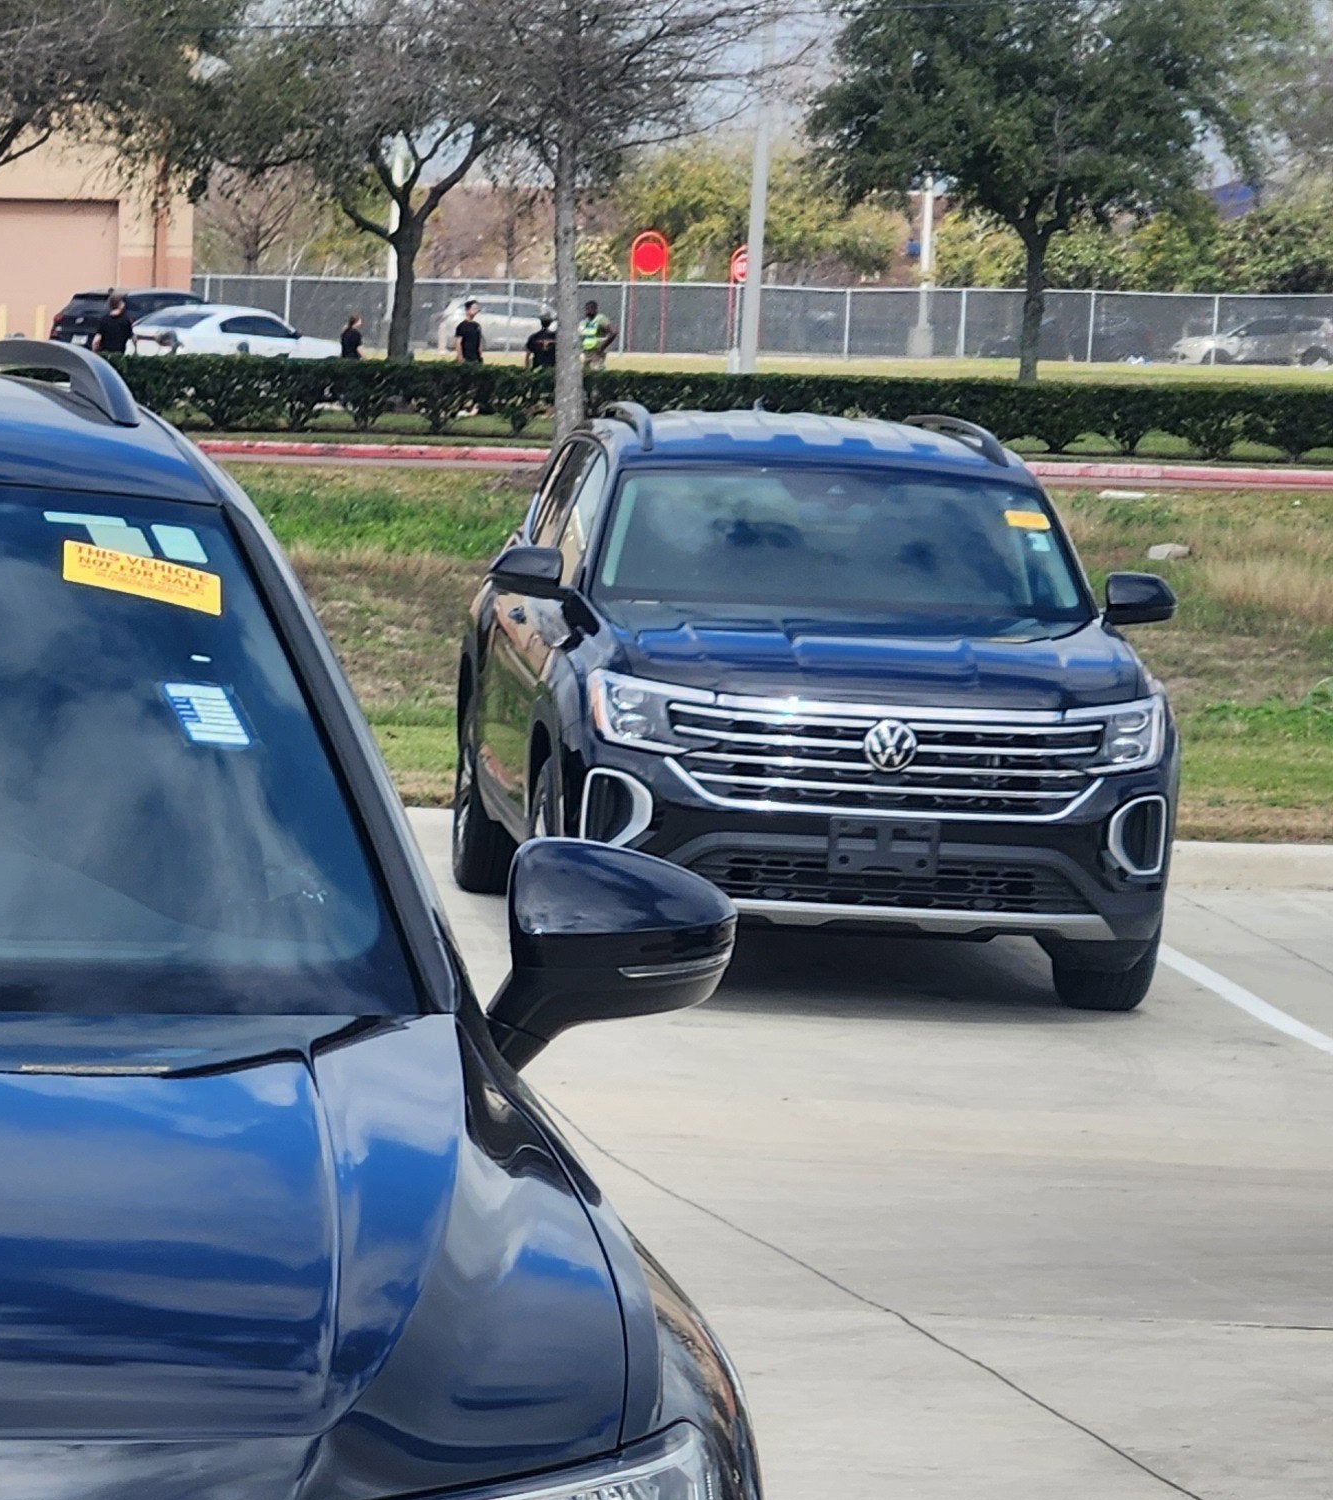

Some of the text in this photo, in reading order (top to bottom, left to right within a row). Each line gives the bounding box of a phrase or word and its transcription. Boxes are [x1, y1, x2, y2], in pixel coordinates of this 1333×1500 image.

[76, 545, 120, 562] THIS
[126, 556, 209, 584] VEHICLE
[79, 556, 112, 570] NOT
[119, 564, 154, 579] FOR
[161, 574, 206, 591] SALE
